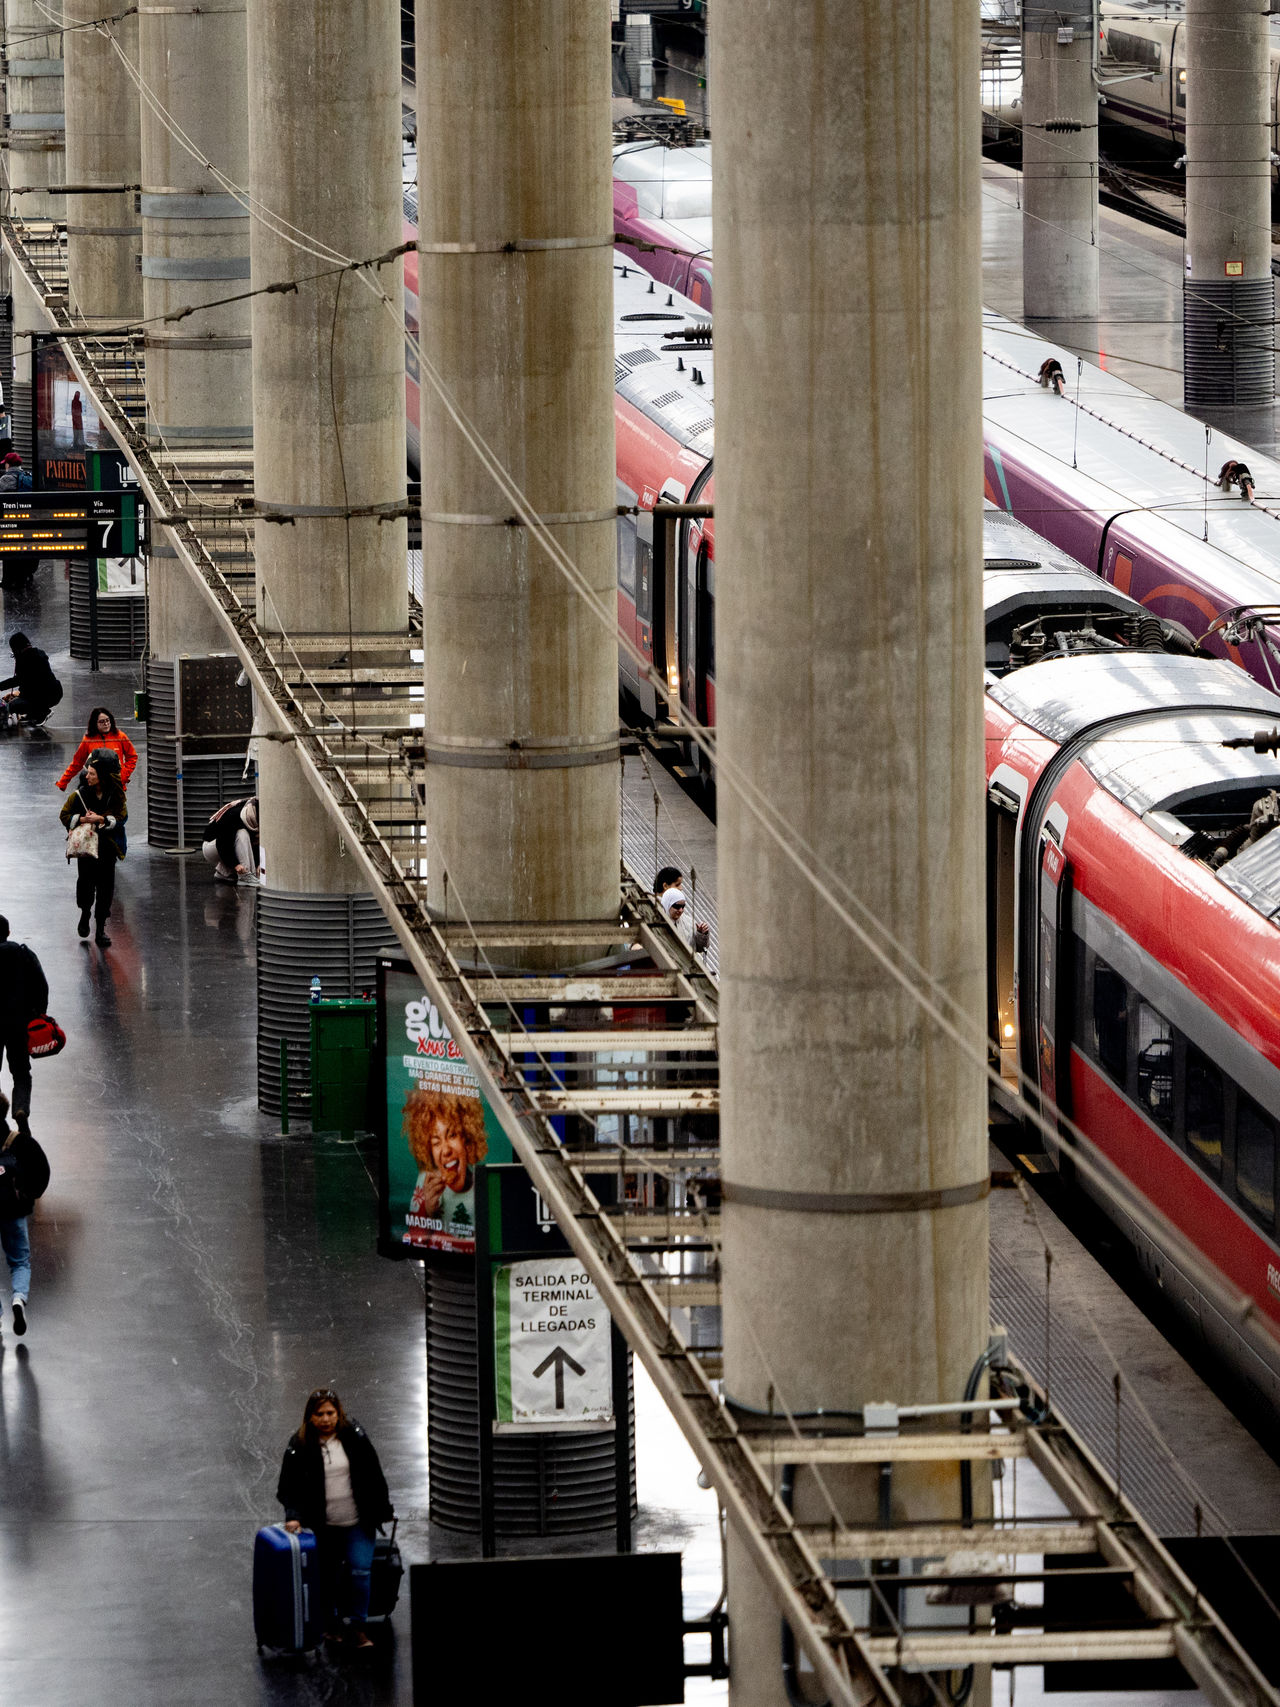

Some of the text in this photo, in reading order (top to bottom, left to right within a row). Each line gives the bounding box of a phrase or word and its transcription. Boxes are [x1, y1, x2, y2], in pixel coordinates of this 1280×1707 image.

[97, 520, 114, 549] 7
[413, 1059, 439, 1070] EVENTO
[453, 1075, 462, 1085] DE
[419, 1081, 480, 1098] ESTAS NAVIDADES
[405, 1213, 443, 1231] MADRID
[515, 1273, 594, 1287] SALIDA PO
[523, 1289, 593, 1302] TERMINAL
[549, 1305, 568, 1317] DE
[521, 1318, 596, 1332] LLEGADAS
